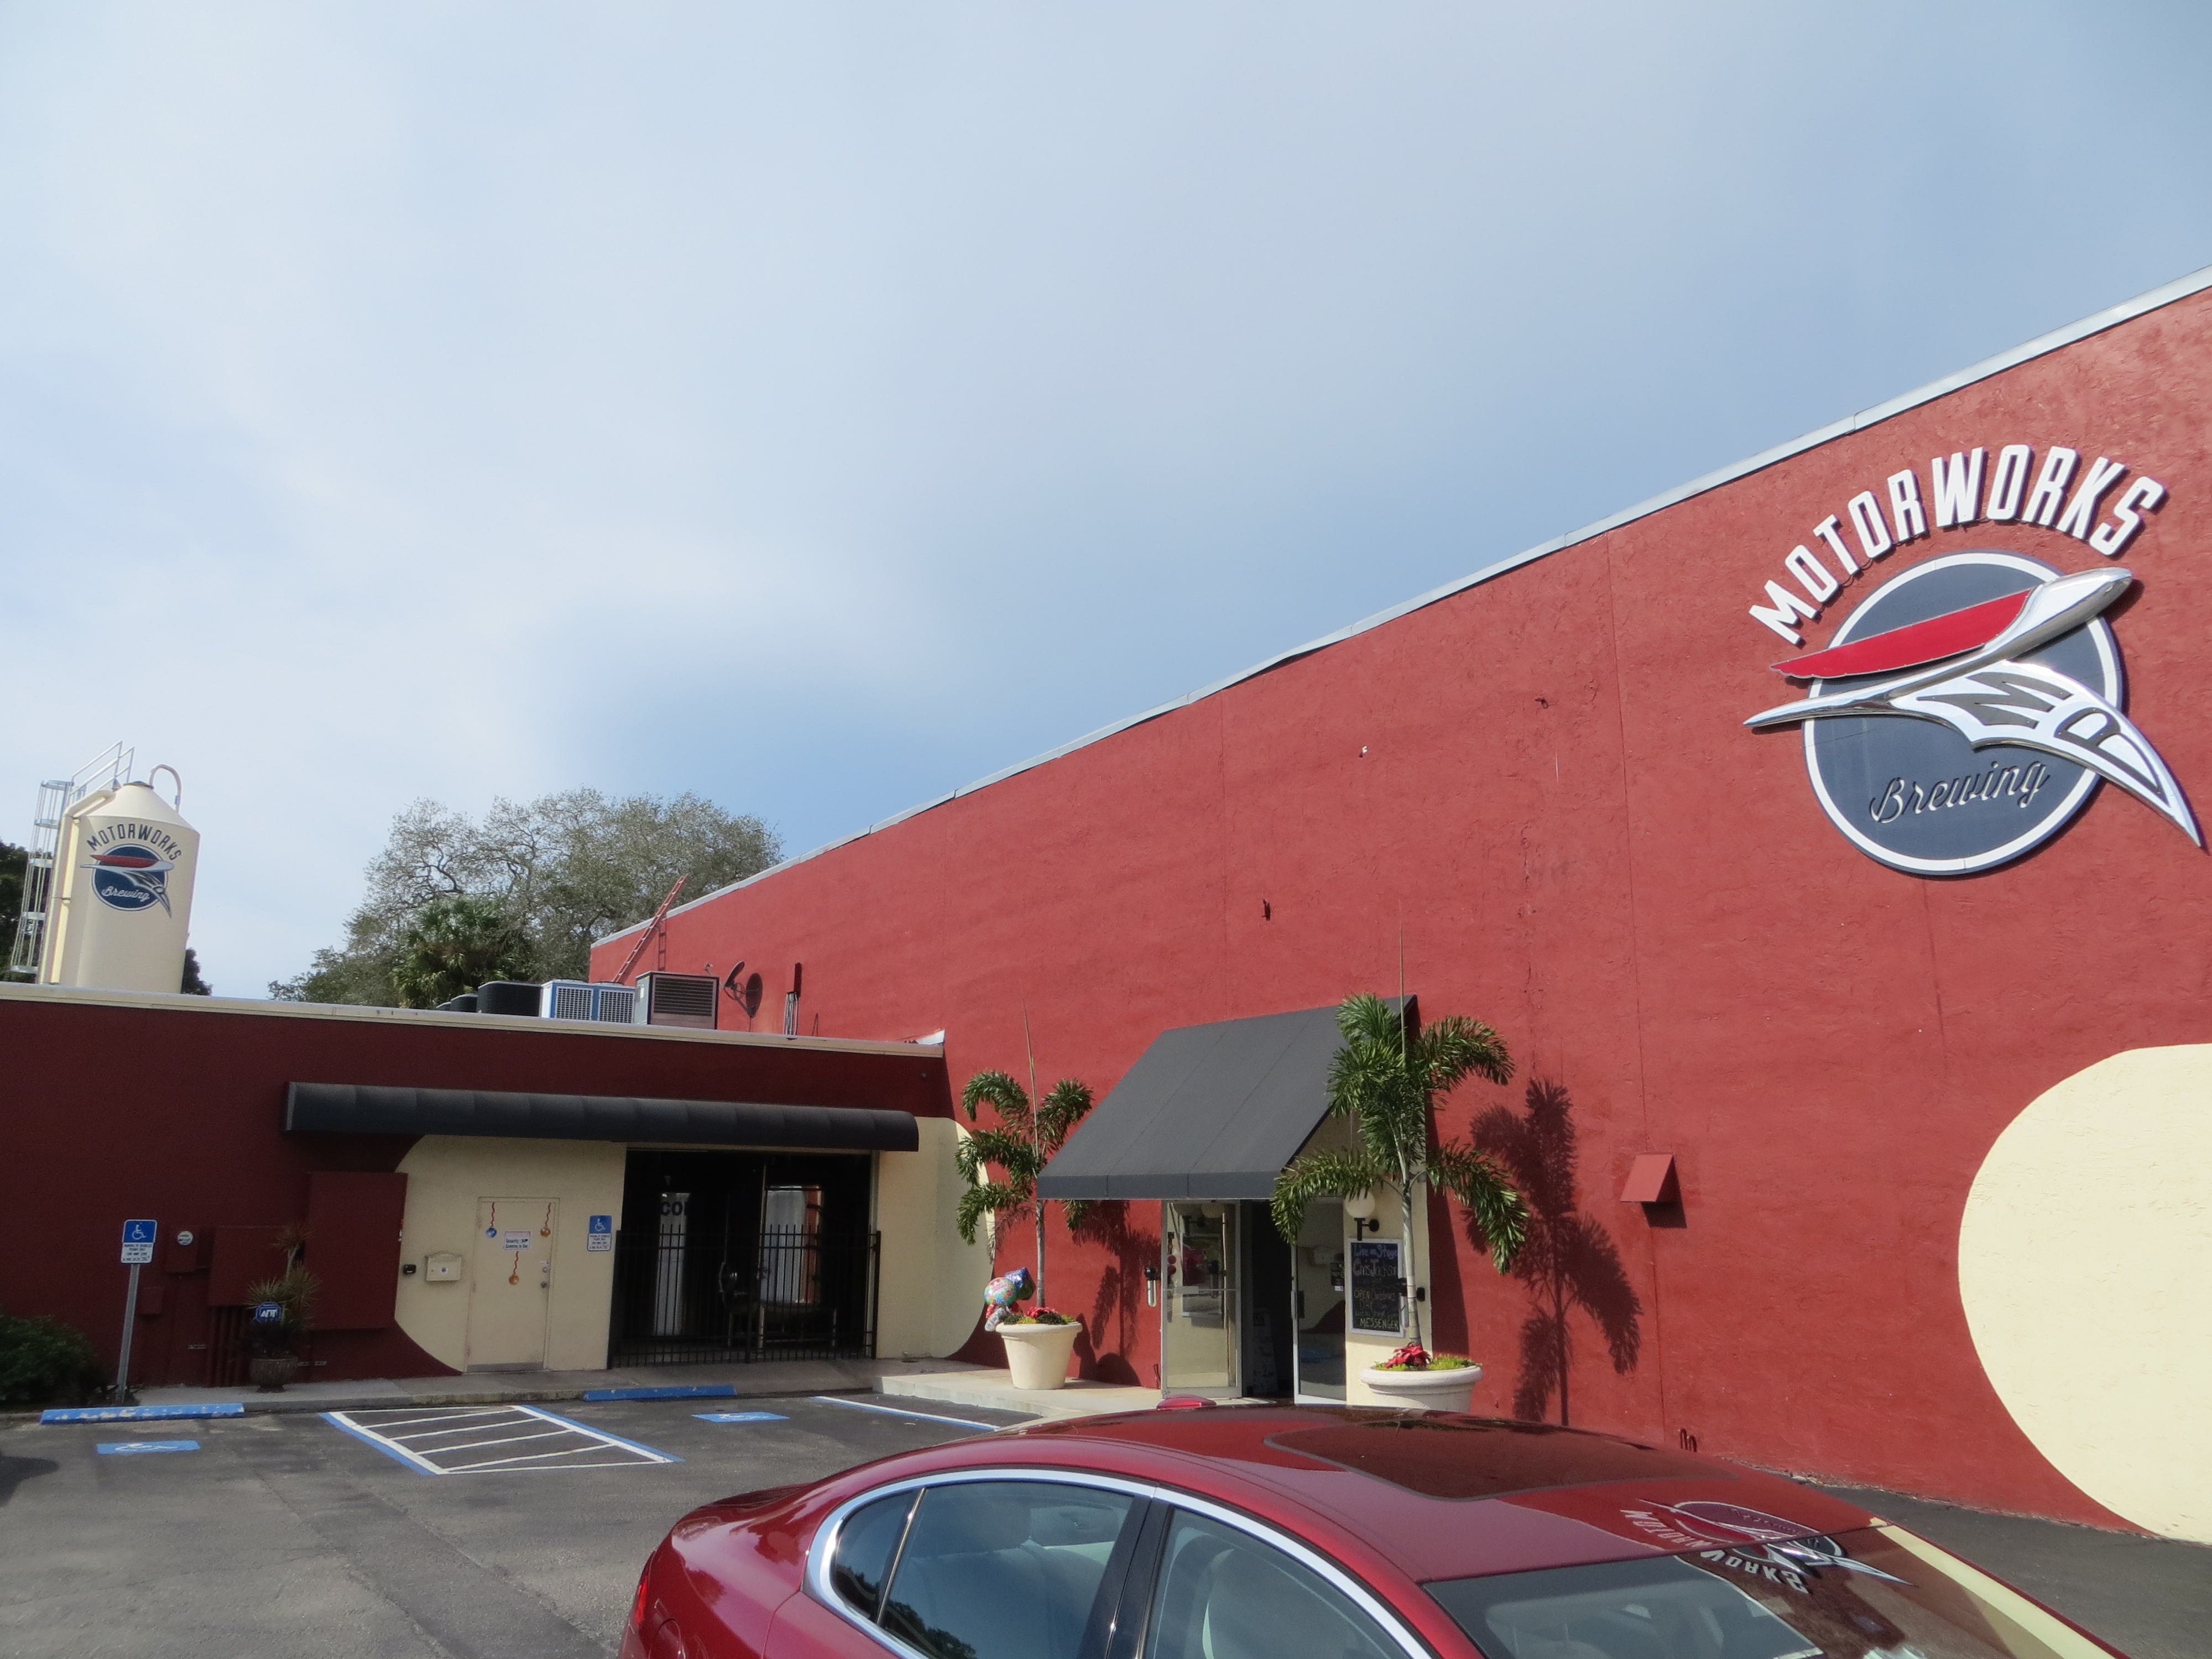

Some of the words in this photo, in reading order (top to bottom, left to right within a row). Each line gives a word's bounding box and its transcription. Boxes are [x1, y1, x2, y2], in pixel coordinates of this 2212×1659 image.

[1749, 444, 2165, 645] MOTORWORKS
[1870, 760, 2051, 823] Brewing
[86, 823, 181, 860] MOTORWORKS
[102, 886, 150, 902] Brewing
[1354, 1290, 1370, 1300] OPEN
[1360, 1318, 1399, 1330] MESSENGER
